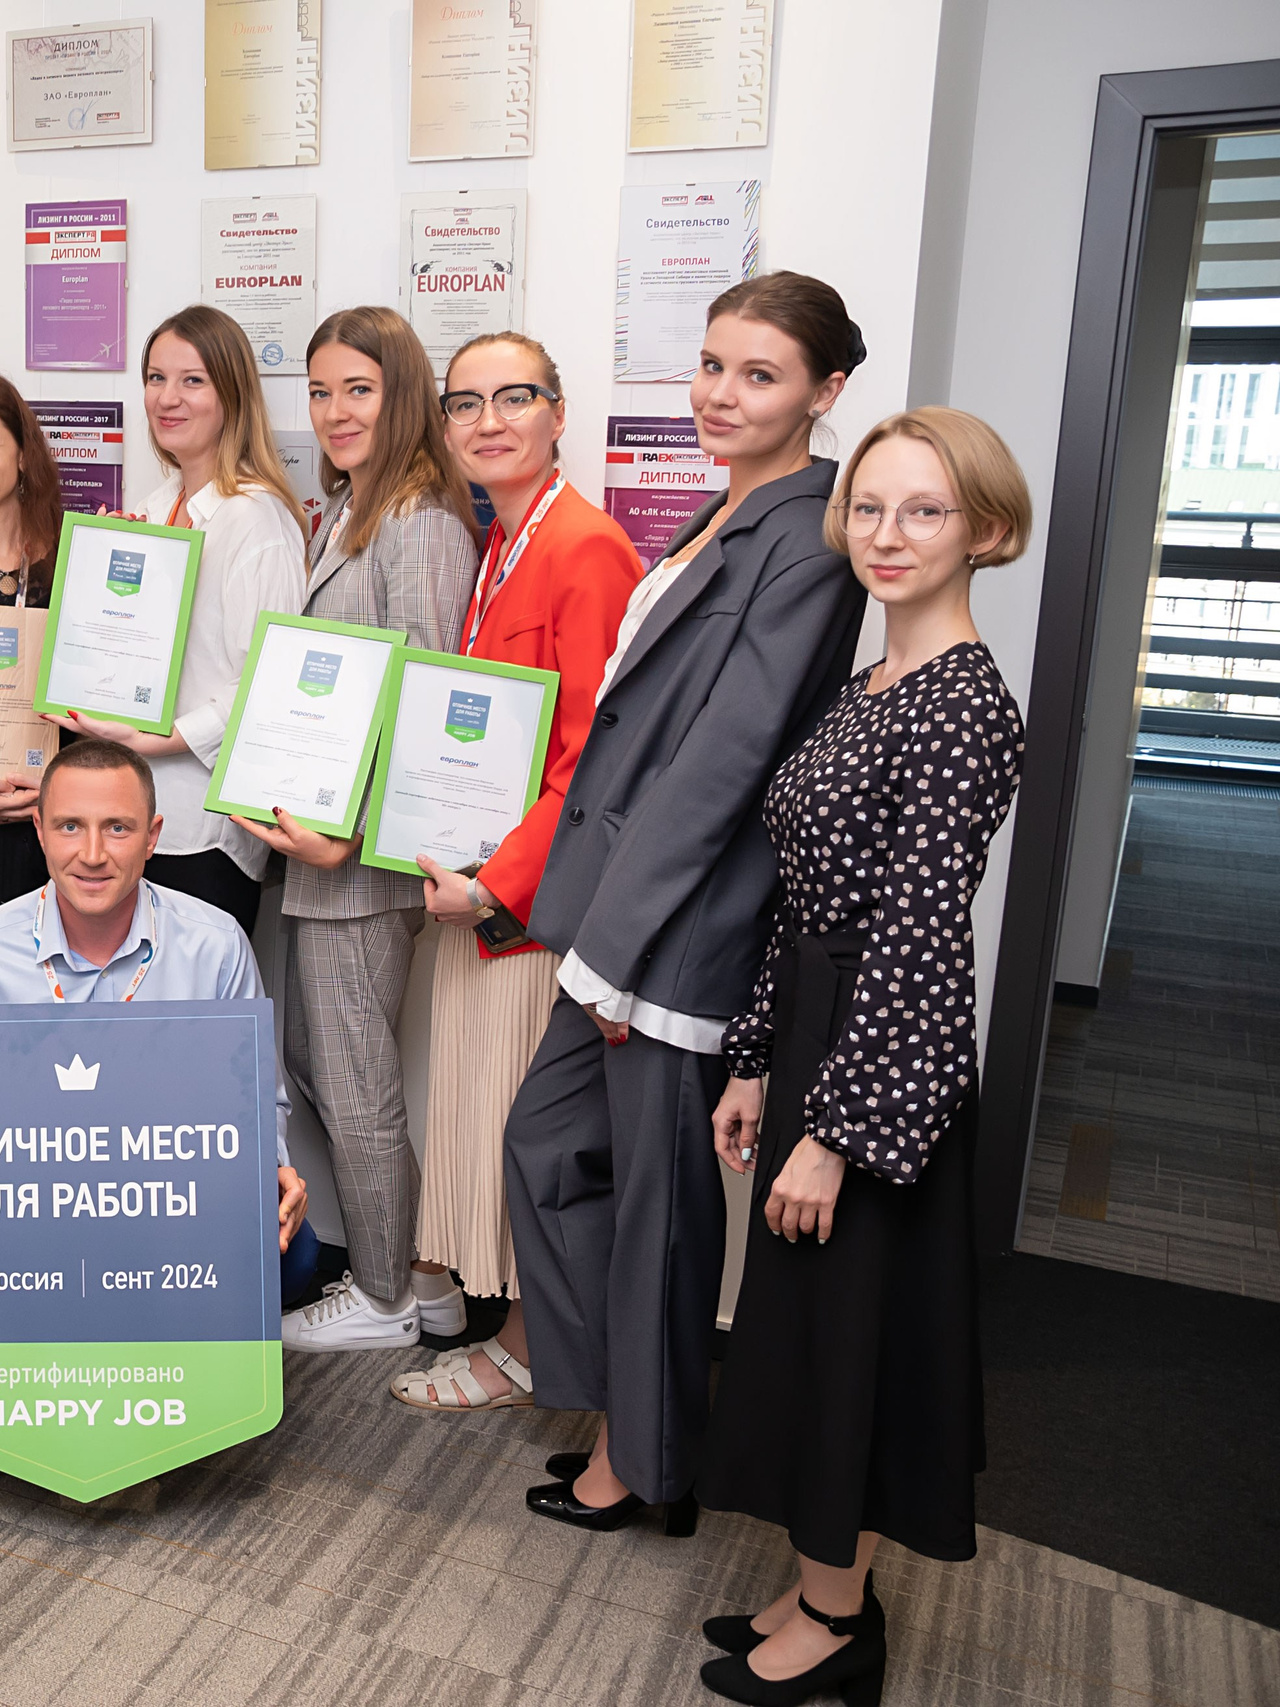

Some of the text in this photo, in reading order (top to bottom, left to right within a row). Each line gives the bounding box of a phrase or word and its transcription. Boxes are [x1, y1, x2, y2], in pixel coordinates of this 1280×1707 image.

[441, 6, 484, 21] Диплом
[232, 21, 273, 40] Диплом
[54, 39, 99, 53] ДИПЛОМ
[44, 90, 112, 101] ЗАО «Европлан»
[37, 215, 62, 224] ЛИЗИНГ
[69, 214, 93, 223] РОССИИ
[646, 218, 730, 229] Свидетельство
[220, 228, 298, 238] Свидетельство
[424, 226, 500, 238] Свидетельство
[50, 248, 100, 260] ДИПЛОМ
[662, 258, 710, 266] ЕВРОПЛАН
[62, 276, 89, 284] Europlan
[216, 275, 302, 289] EUROPLAN
[417, 274, 506, 293] EUROPLAN
[50, 431, 72, 439] RAEX
[625, 434, 656, 442] ЛИЗИНГ
[657, 434, 663, 442] В
[50, 448, 97, 458] ДИПЛОМ
[643, 453, 673, 462] RAEX
[65, 479, 103, 488] «Европлан»
[639, 471, 706, 485] ДИПЛОМ
[642, 508, 658, 516] «ЛК
[660, 508, 694, 518] «Европл
[290, 710, 325, 720] европлан
[440, 756, 478, 767] европлан
[121, 1124, 240, 1161] МЕСТО
[52, 1180, 197, 1218] РАБОТЫ
[101, 1269, 153, 1291] сент
[161, 1264, 218, 1290] 2024
[114, 1399, 186, 1426] JOB
